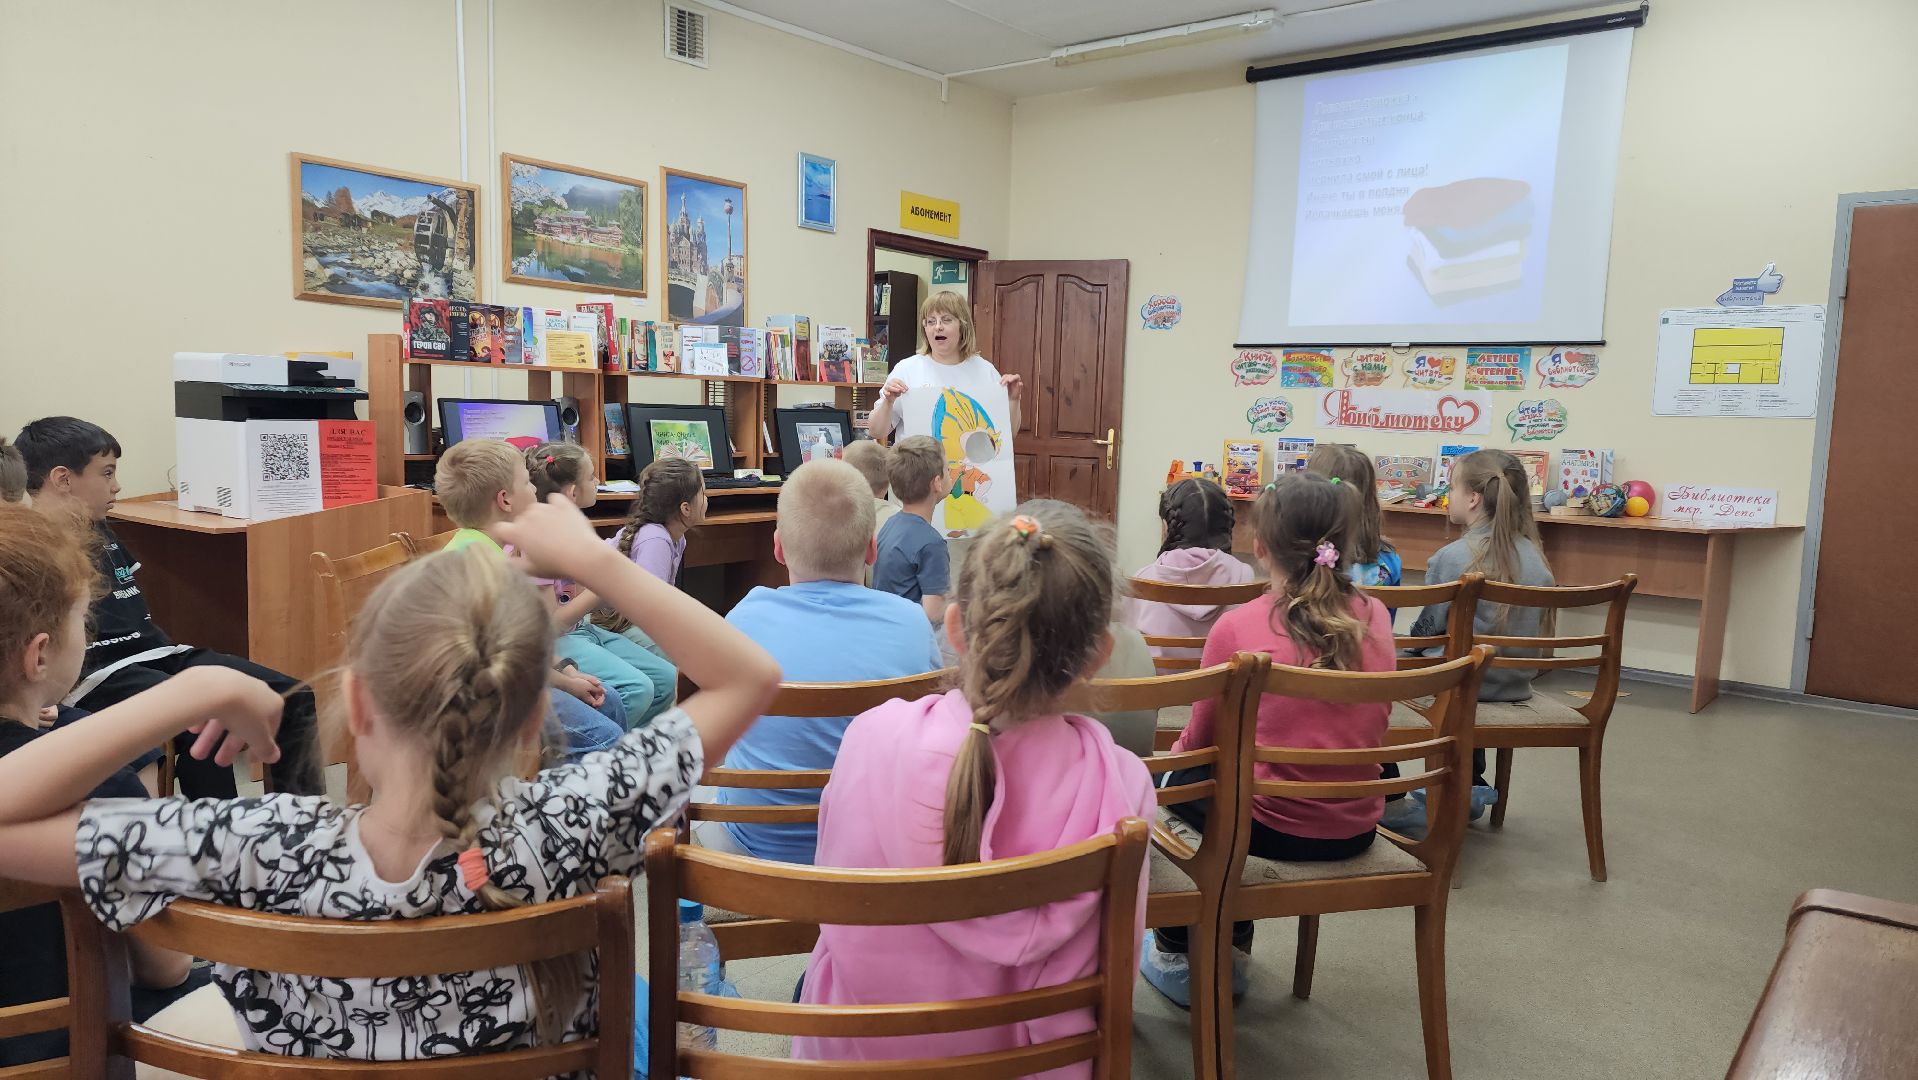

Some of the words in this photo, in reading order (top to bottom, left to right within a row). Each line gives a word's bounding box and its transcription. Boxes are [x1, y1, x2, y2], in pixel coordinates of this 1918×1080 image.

[910, 205, 952, 223] АБОНЕМЕНТ
[413, 340, 432, 350] ГЕРОИ
[433, 342, 446, 351] СВО
[1415, 355, 1427, 369] Я
[1476, 353, 1520, 363] ЛЕТНЕЕ
[1551, 353, 1562, 366] Я
[1561, 459, 1595, 468] АНАТОМИЯ
[1667, 485, 1773, 505] Библиотека
